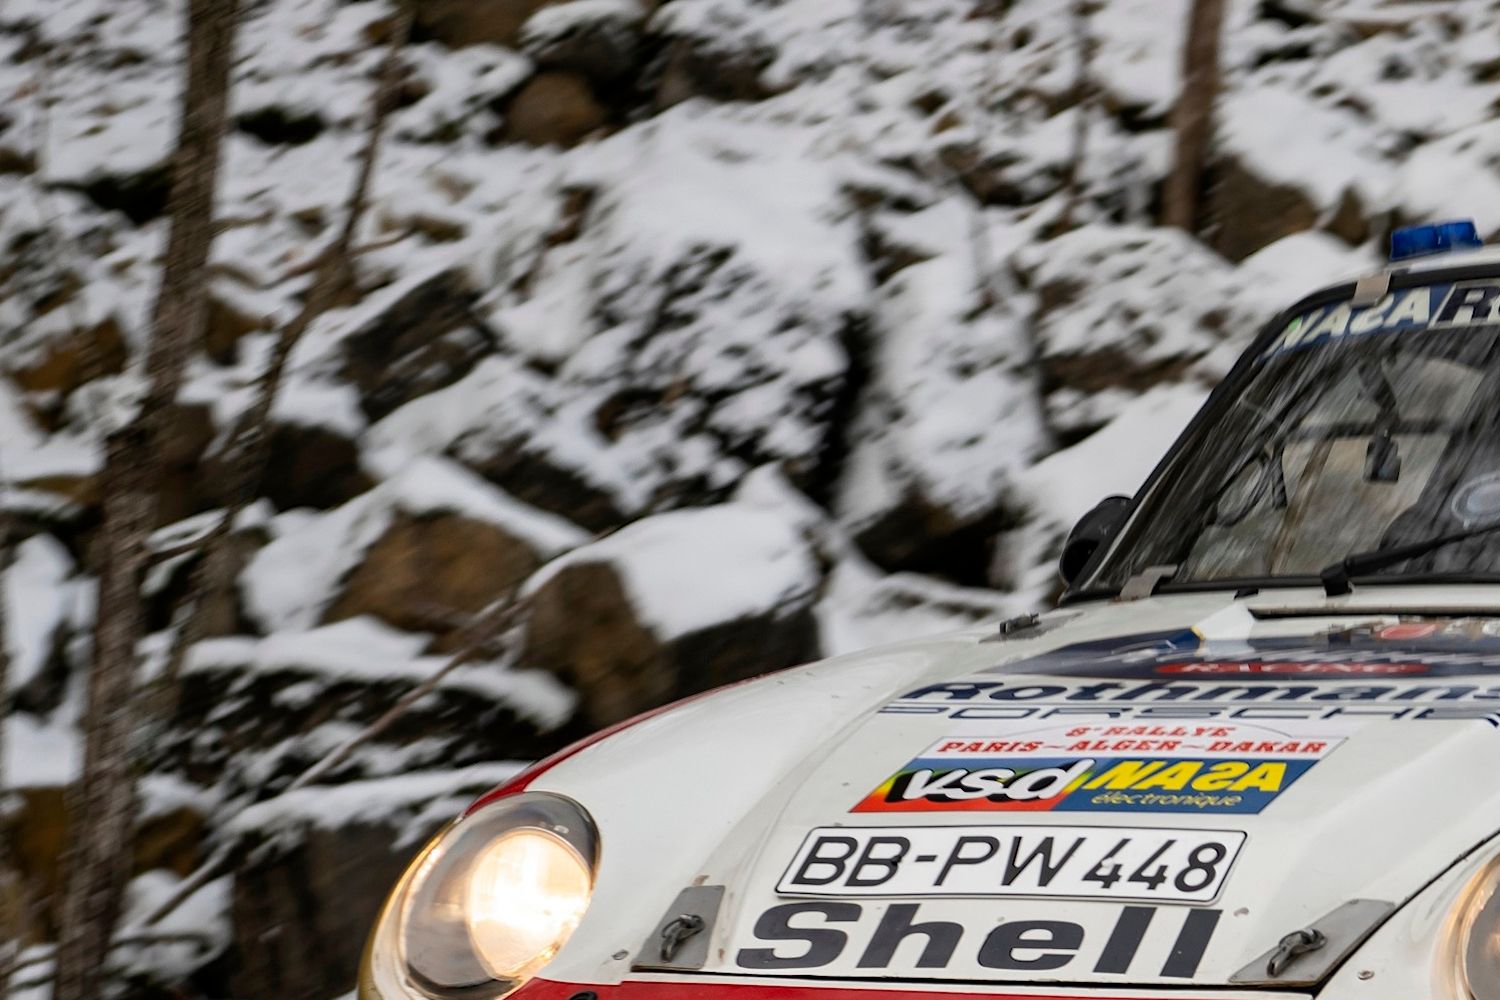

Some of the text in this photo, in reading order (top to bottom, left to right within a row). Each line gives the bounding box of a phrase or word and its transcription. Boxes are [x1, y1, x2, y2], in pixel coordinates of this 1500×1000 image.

[791, 834, 1228, 893] BB-PW 448
[735, 901, 1224, 979] Shell
